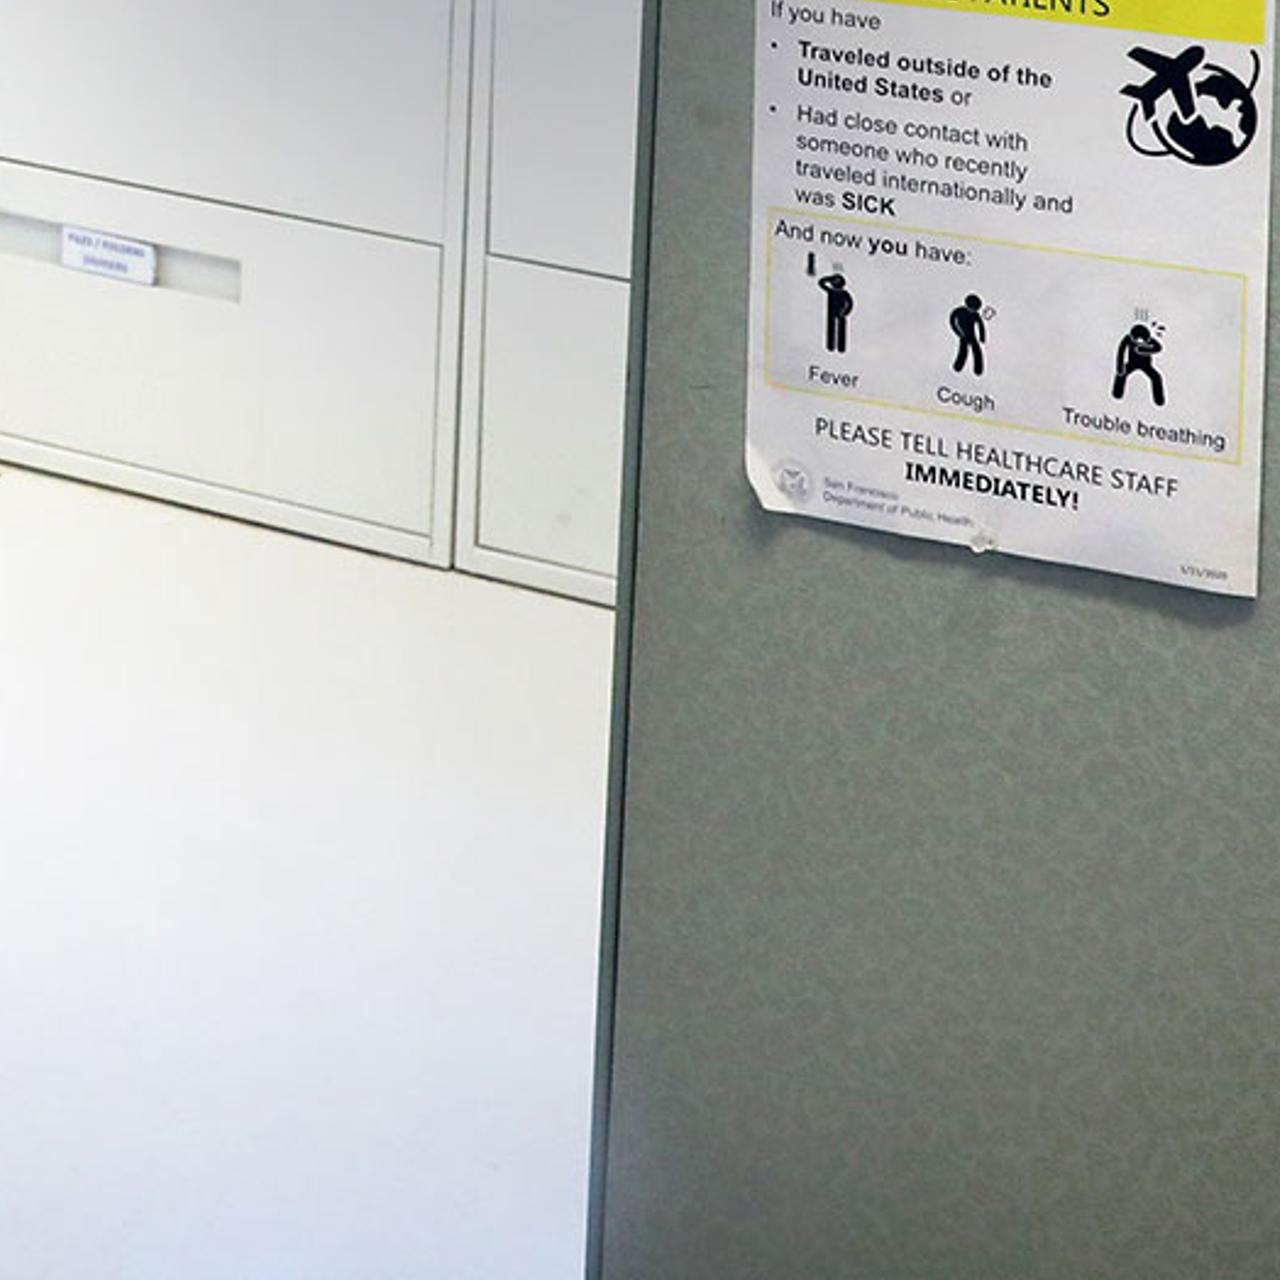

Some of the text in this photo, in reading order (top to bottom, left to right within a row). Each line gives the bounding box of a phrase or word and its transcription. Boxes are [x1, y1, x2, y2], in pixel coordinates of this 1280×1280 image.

[770, 0, 883, 31] If you have
[796, 67, 973, 107] United States or
[797, 39, 1053, 89] Traveled outside of the
[796, 103, 1029, 152] Had close contact with
[795, 134, 1029, 184] someone who recently
[794, 159, 1074, 215] traveled internationally and
[794, 188, 897, 217] was SICK
[774, 218, 973, 267] And now you have:
[807, 364, 861, 390] Fever
[936, 384, 997, 413] Cough
[1061, 405, 1228, 454] Trouble breathing
[814, 416, 1180, 499] PLEASE TELL HEALTHCARE STAFF
[903, 460, 1081, 512] IMMEDIATELY!
